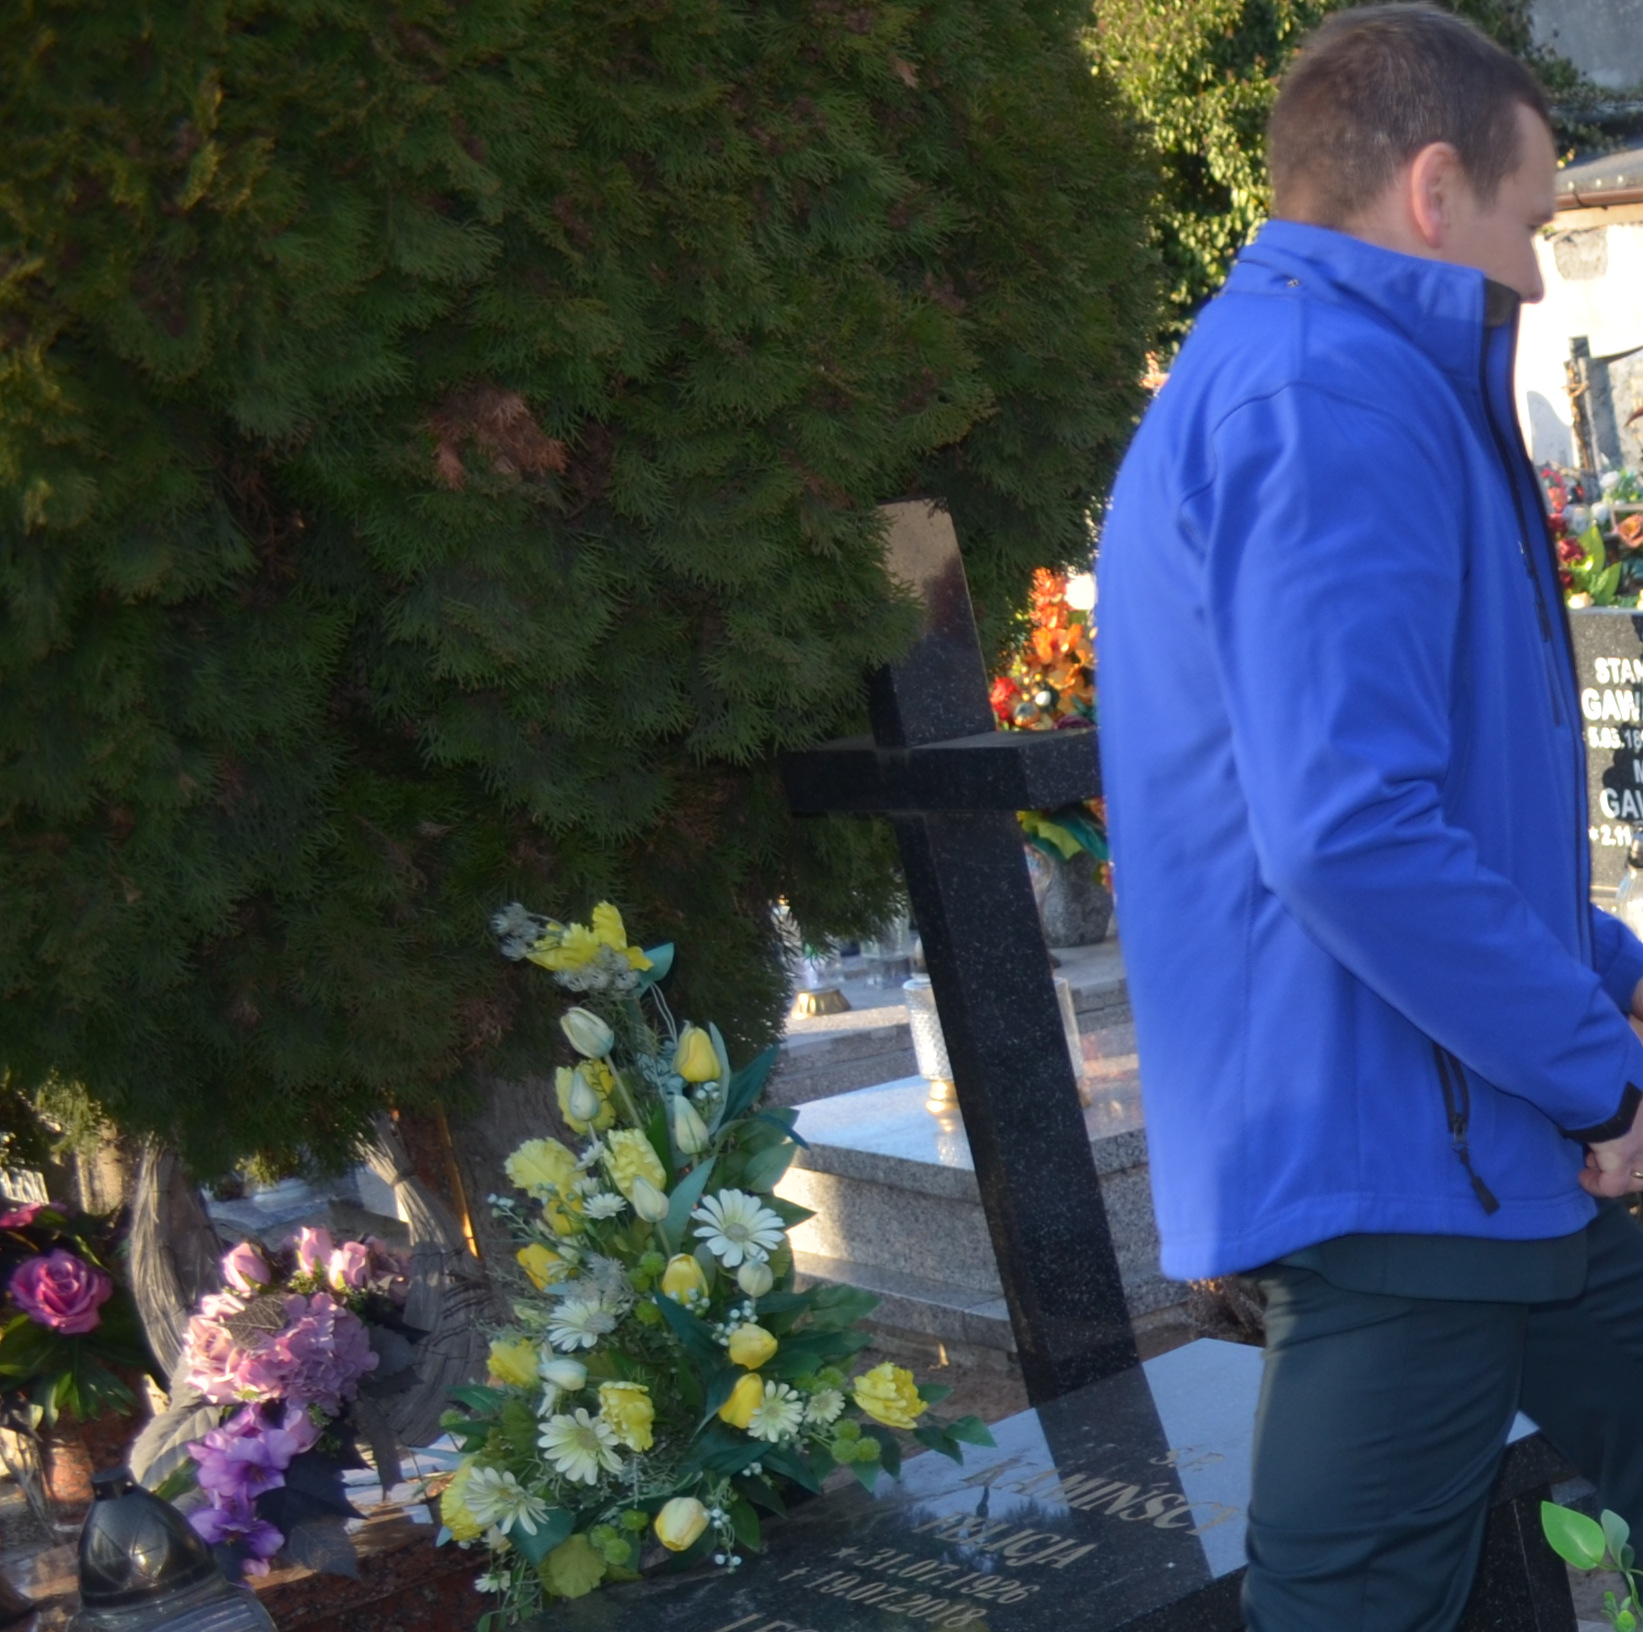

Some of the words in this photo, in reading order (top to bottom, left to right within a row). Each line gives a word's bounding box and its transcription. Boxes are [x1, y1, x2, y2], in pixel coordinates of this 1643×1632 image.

[911, 1511, 1099, 1570] FELICJA
[803, 1570, 988, 1630] 19.07.2018
[853, 1547, 1041, 1605] 31.07.1926
